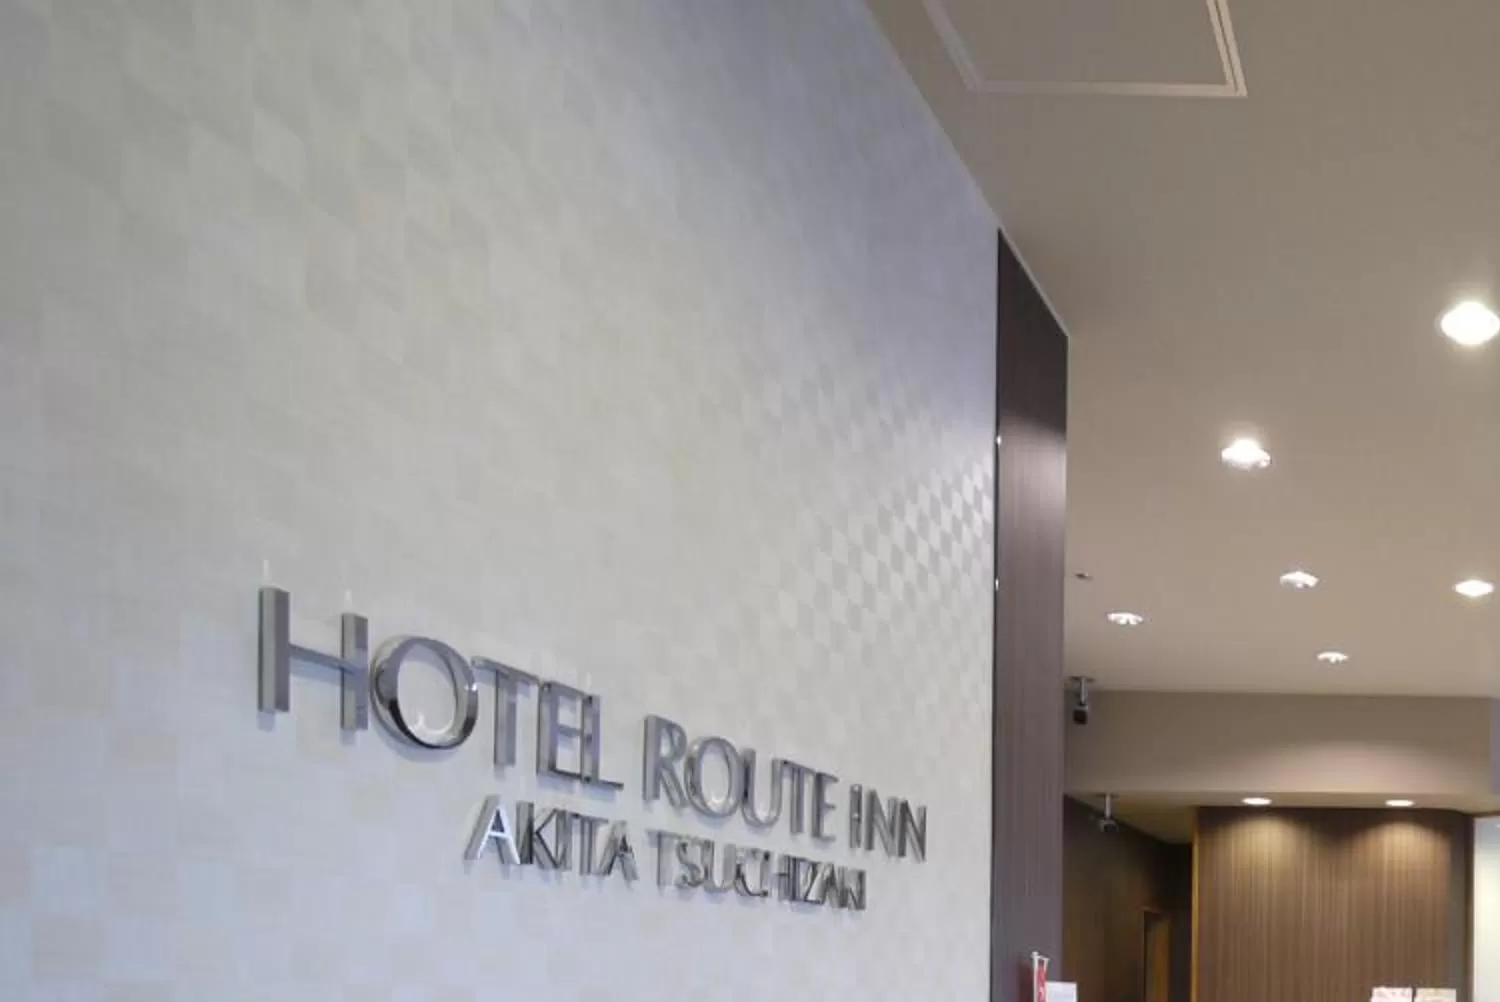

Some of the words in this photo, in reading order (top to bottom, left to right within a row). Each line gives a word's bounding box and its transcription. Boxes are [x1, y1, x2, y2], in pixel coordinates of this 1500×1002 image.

[258, 585, 624, 790] HOTEL
[643, 714, 839, 843] ROUTE
[849, 783, 928, 863] INN
[465, 794, 639, 882] AKITA
